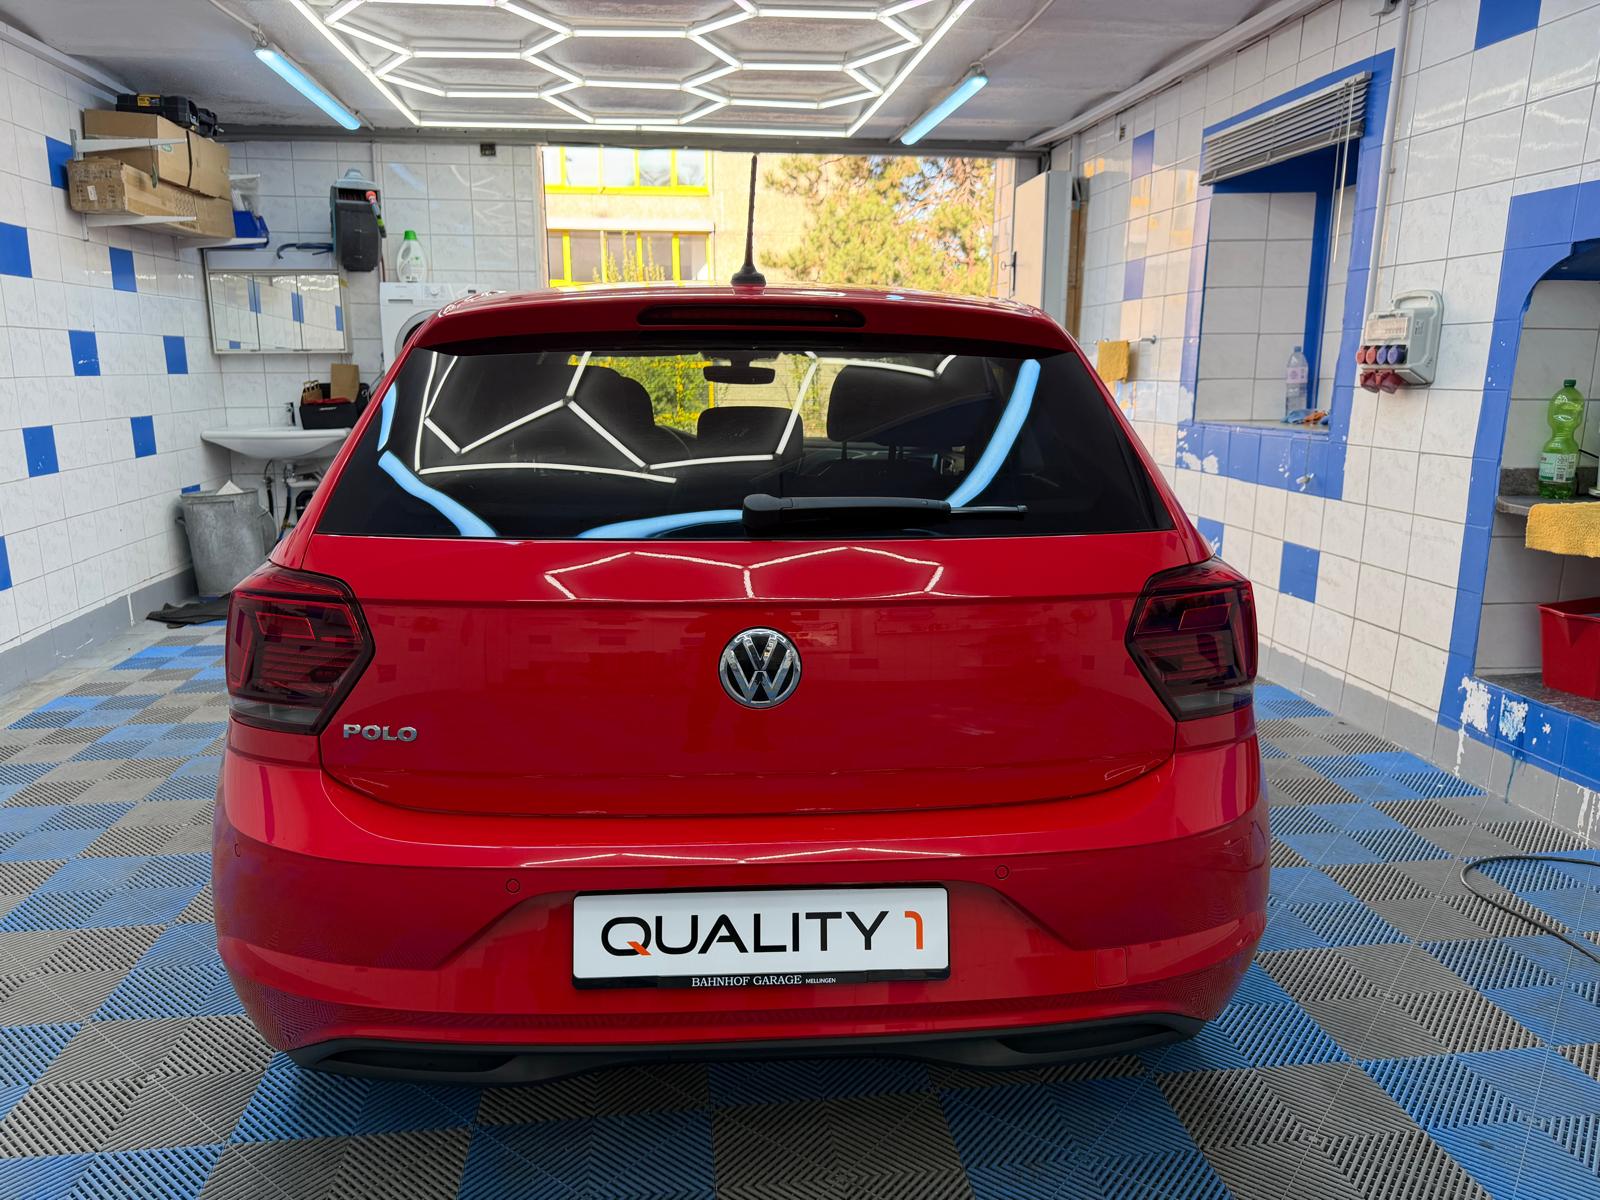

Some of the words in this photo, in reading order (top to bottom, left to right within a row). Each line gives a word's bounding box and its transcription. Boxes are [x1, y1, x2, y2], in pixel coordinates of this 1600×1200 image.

[720, 628, 801, 708] VW
[342, 723, 419, 742] POLO
[600, 910, 890, 957] QUALITY
[691, 976, 751, 987] BAHNHOF
[753, 974, 803, 986] GARAGE
